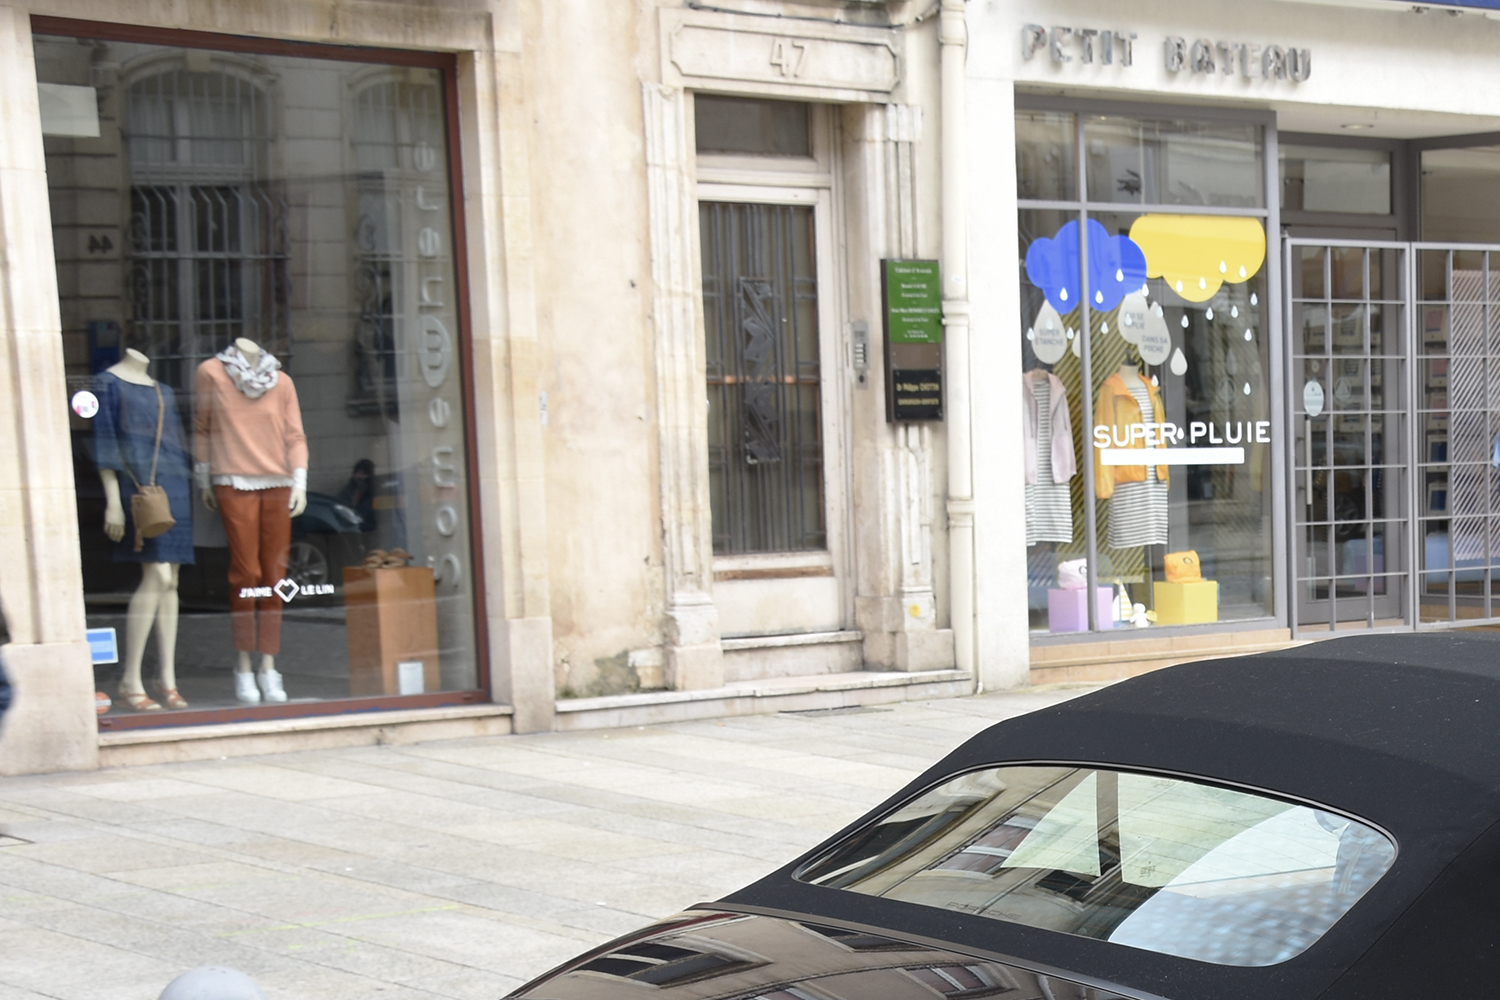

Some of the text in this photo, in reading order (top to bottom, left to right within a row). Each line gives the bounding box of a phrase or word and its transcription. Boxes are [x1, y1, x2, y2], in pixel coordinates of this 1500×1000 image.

[769, 38, 806, 77] 47
[1021, 23, 1311, 82] PETIT BATEAU
[1093, 421, 1270, 448] SUPER PLUIE
[301, 585, 315, 595] LE
[316, 584, 334, 595] LIN
